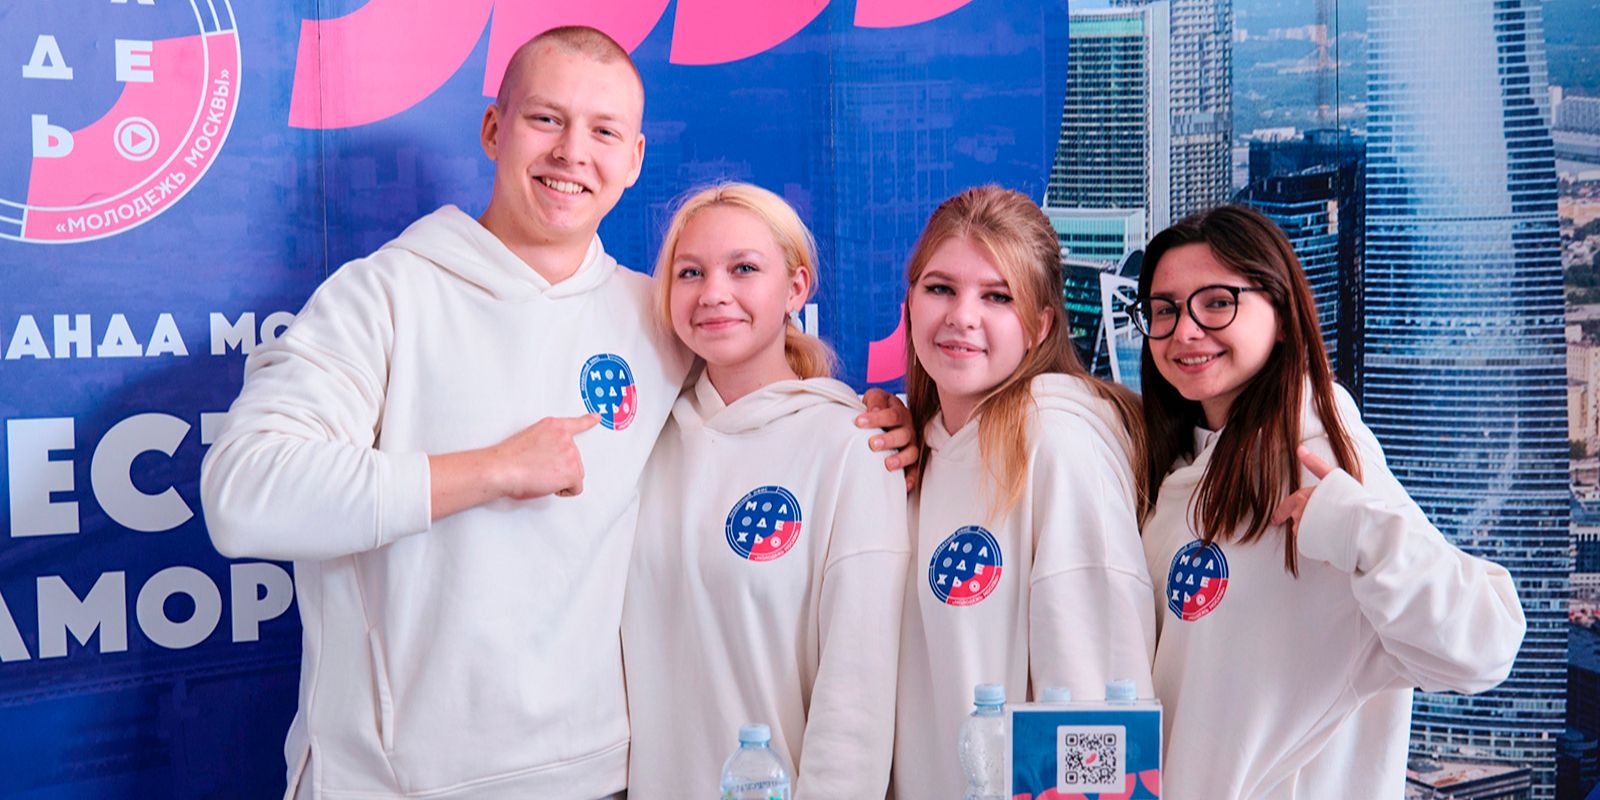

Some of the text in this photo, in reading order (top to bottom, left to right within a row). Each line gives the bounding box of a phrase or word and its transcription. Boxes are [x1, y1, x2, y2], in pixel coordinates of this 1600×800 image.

[55, 69, 230, 233] «МОЛОДЕЖЬ МОСКВЫ»
[0, 311, 302, 360] АНДА МО
